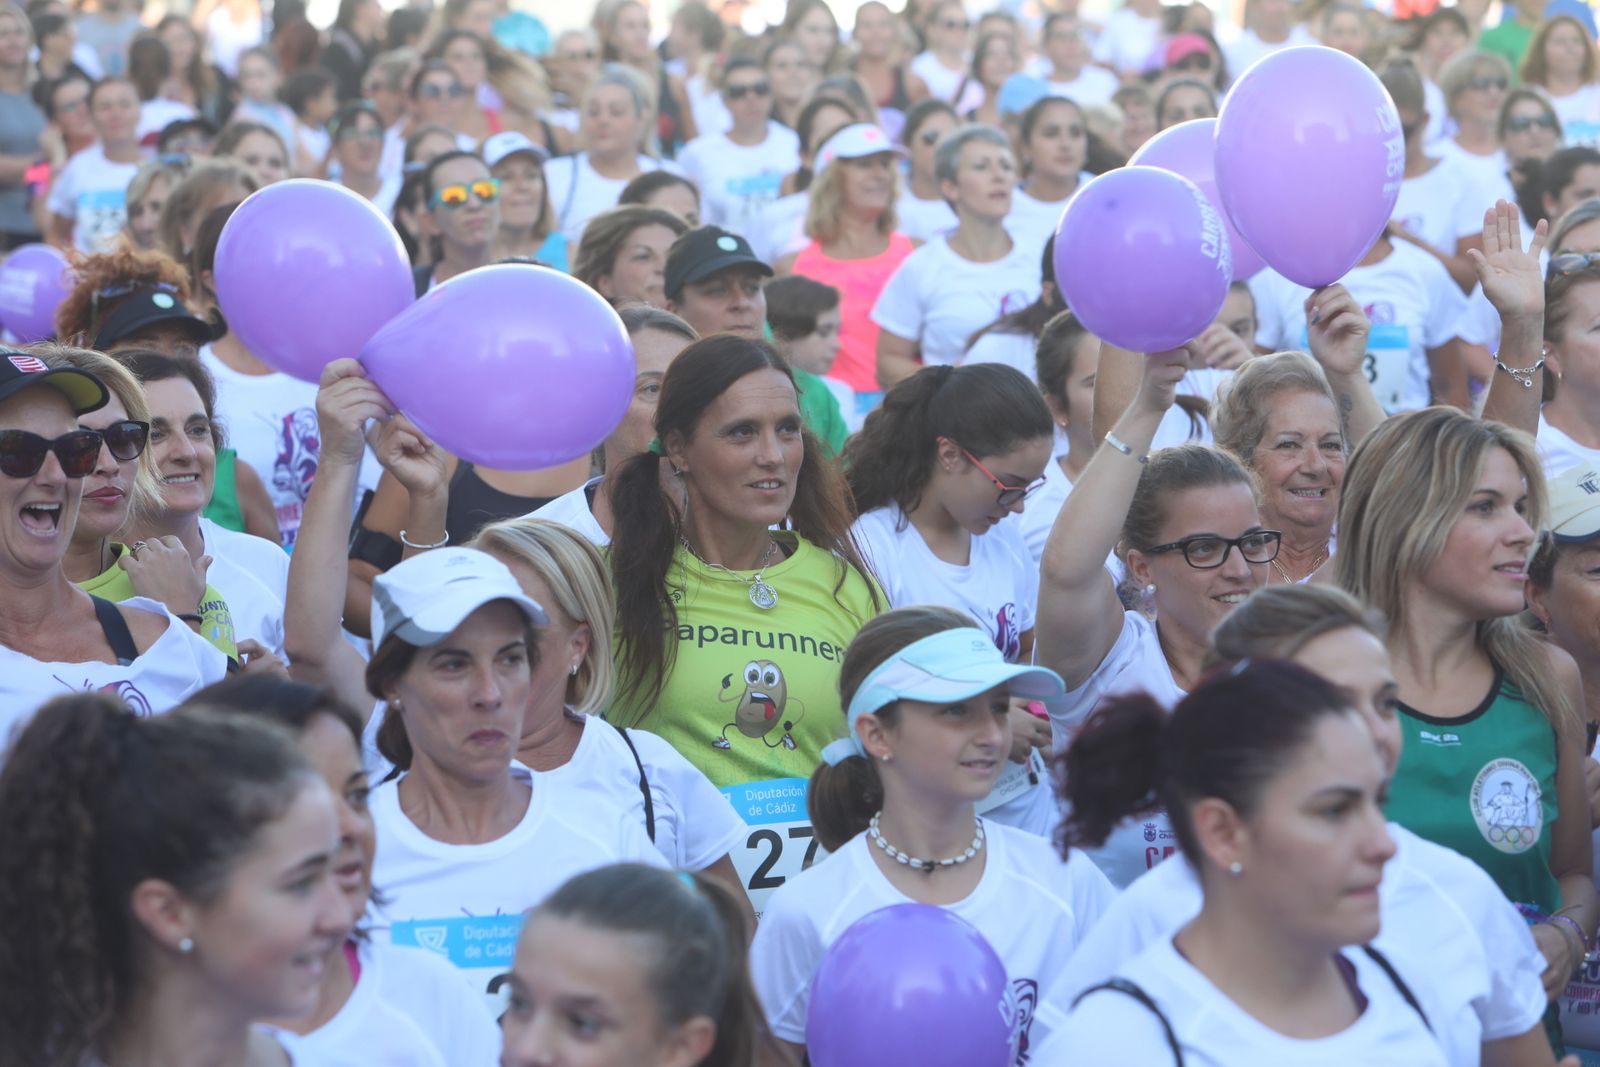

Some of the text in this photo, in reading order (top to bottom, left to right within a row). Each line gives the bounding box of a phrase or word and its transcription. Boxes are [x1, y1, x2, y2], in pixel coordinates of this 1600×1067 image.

[678, 624, 844, 663] aparunner
[745, 785, 804, 802] Diputación
[748, 800, 798, 816] de Cádiz
